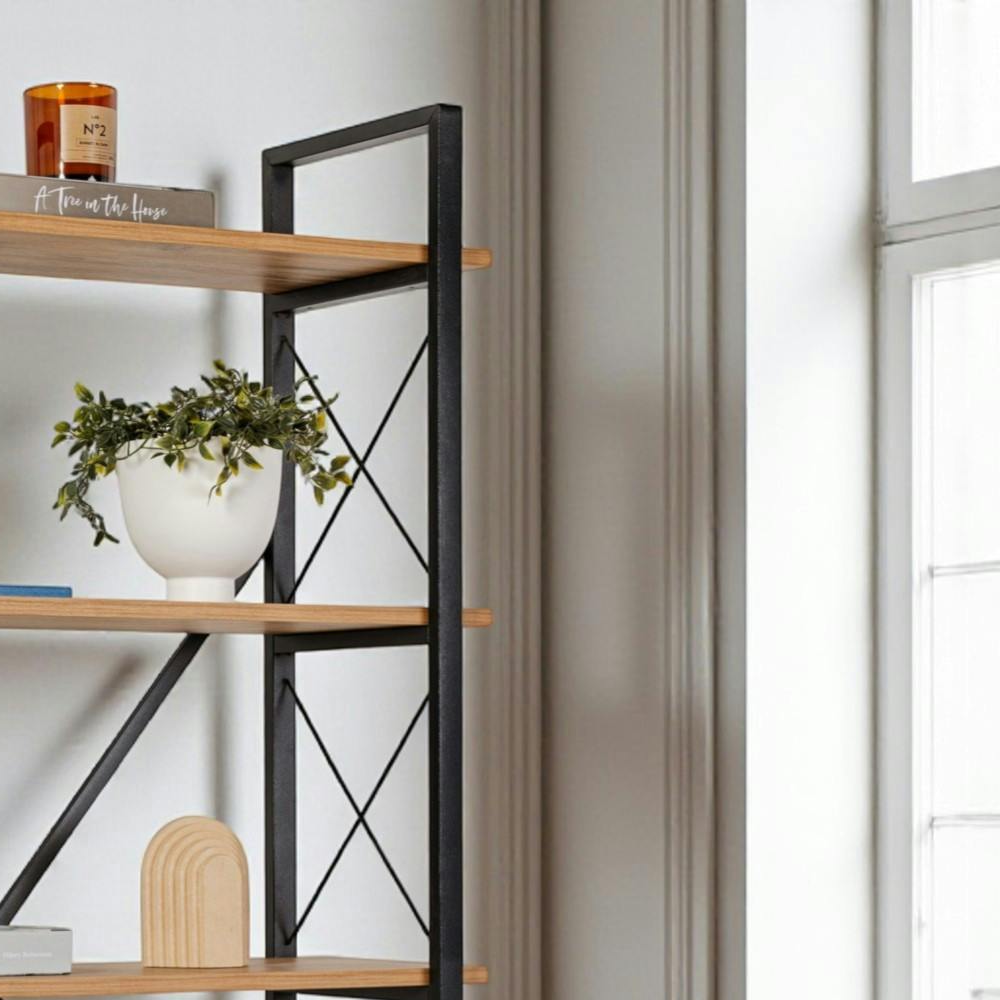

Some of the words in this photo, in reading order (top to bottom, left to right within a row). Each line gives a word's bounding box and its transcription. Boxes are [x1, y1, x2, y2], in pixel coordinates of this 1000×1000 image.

[33, 185, 51, 213] A
[47, 186, 83, 216] Tree
[85, 199, 101, 214] in
[101, 194, 129, 217] the
[131, 192, 168, 223] House
